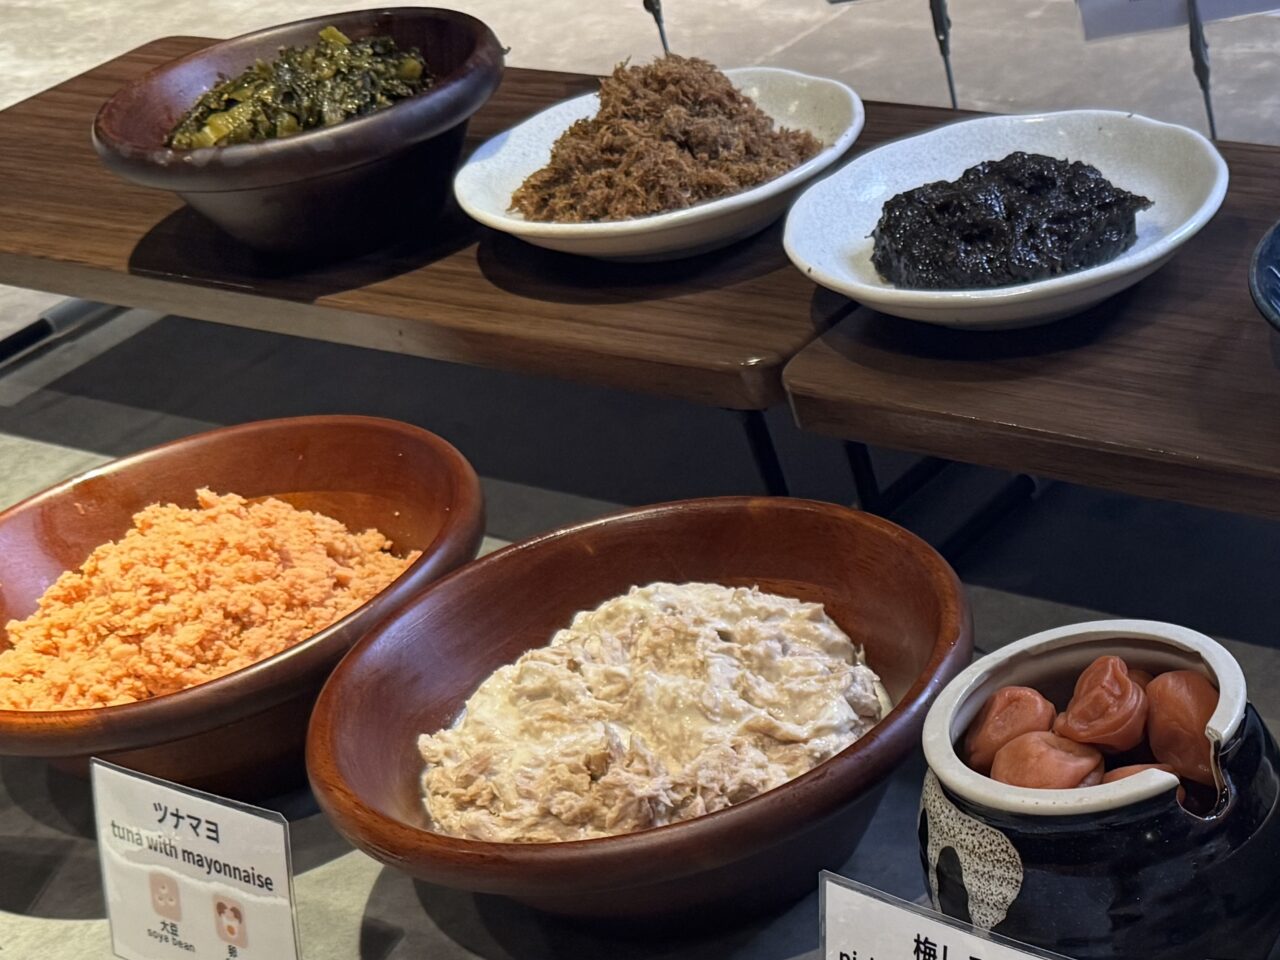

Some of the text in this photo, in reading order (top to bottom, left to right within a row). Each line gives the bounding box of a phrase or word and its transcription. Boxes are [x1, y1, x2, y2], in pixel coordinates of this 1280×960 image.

[153, 802, 220, 843] ツナマヨ
[110, 820, 274, 892] tuna with mayonnaise
[160, 920, 179, 937] 大豆
